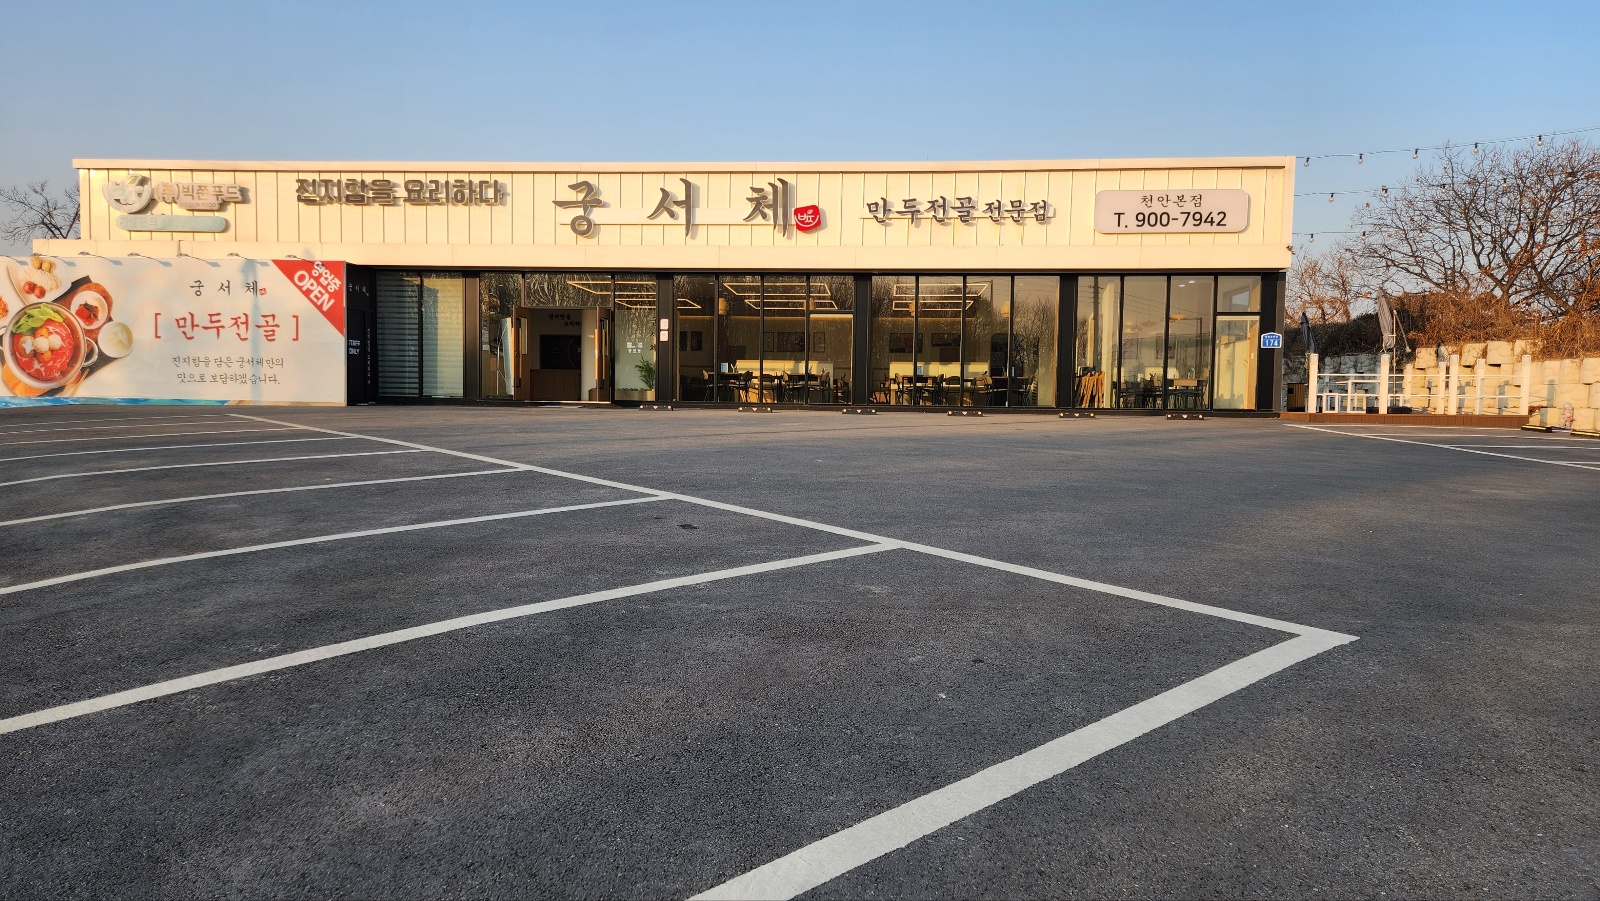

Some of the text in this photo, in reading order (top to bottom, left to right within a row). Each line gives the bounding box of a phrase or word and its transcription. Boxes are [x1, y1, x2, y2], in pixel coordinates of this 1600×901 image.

[294, 178, 503, 204] 진지함을 요리하다
[1140, 193, 1203, 208] 천안본점
[866, 195, 1048, 225] 만두전골 전문점
[1113, 211, 1227, 229] T. 900-7942
[311, 261, 342, 293] 영업중
[189, 279, 258, 298] 궁서체
[293, 270, 335, 312] OPEN
[1265, 339, 1278, 347] 174
[172, 355, 212, 368] 진지함을
[213, 356, 234, 368] 담은
[176, 371, 281, 385] 맛으로 보답하겠습니다.
